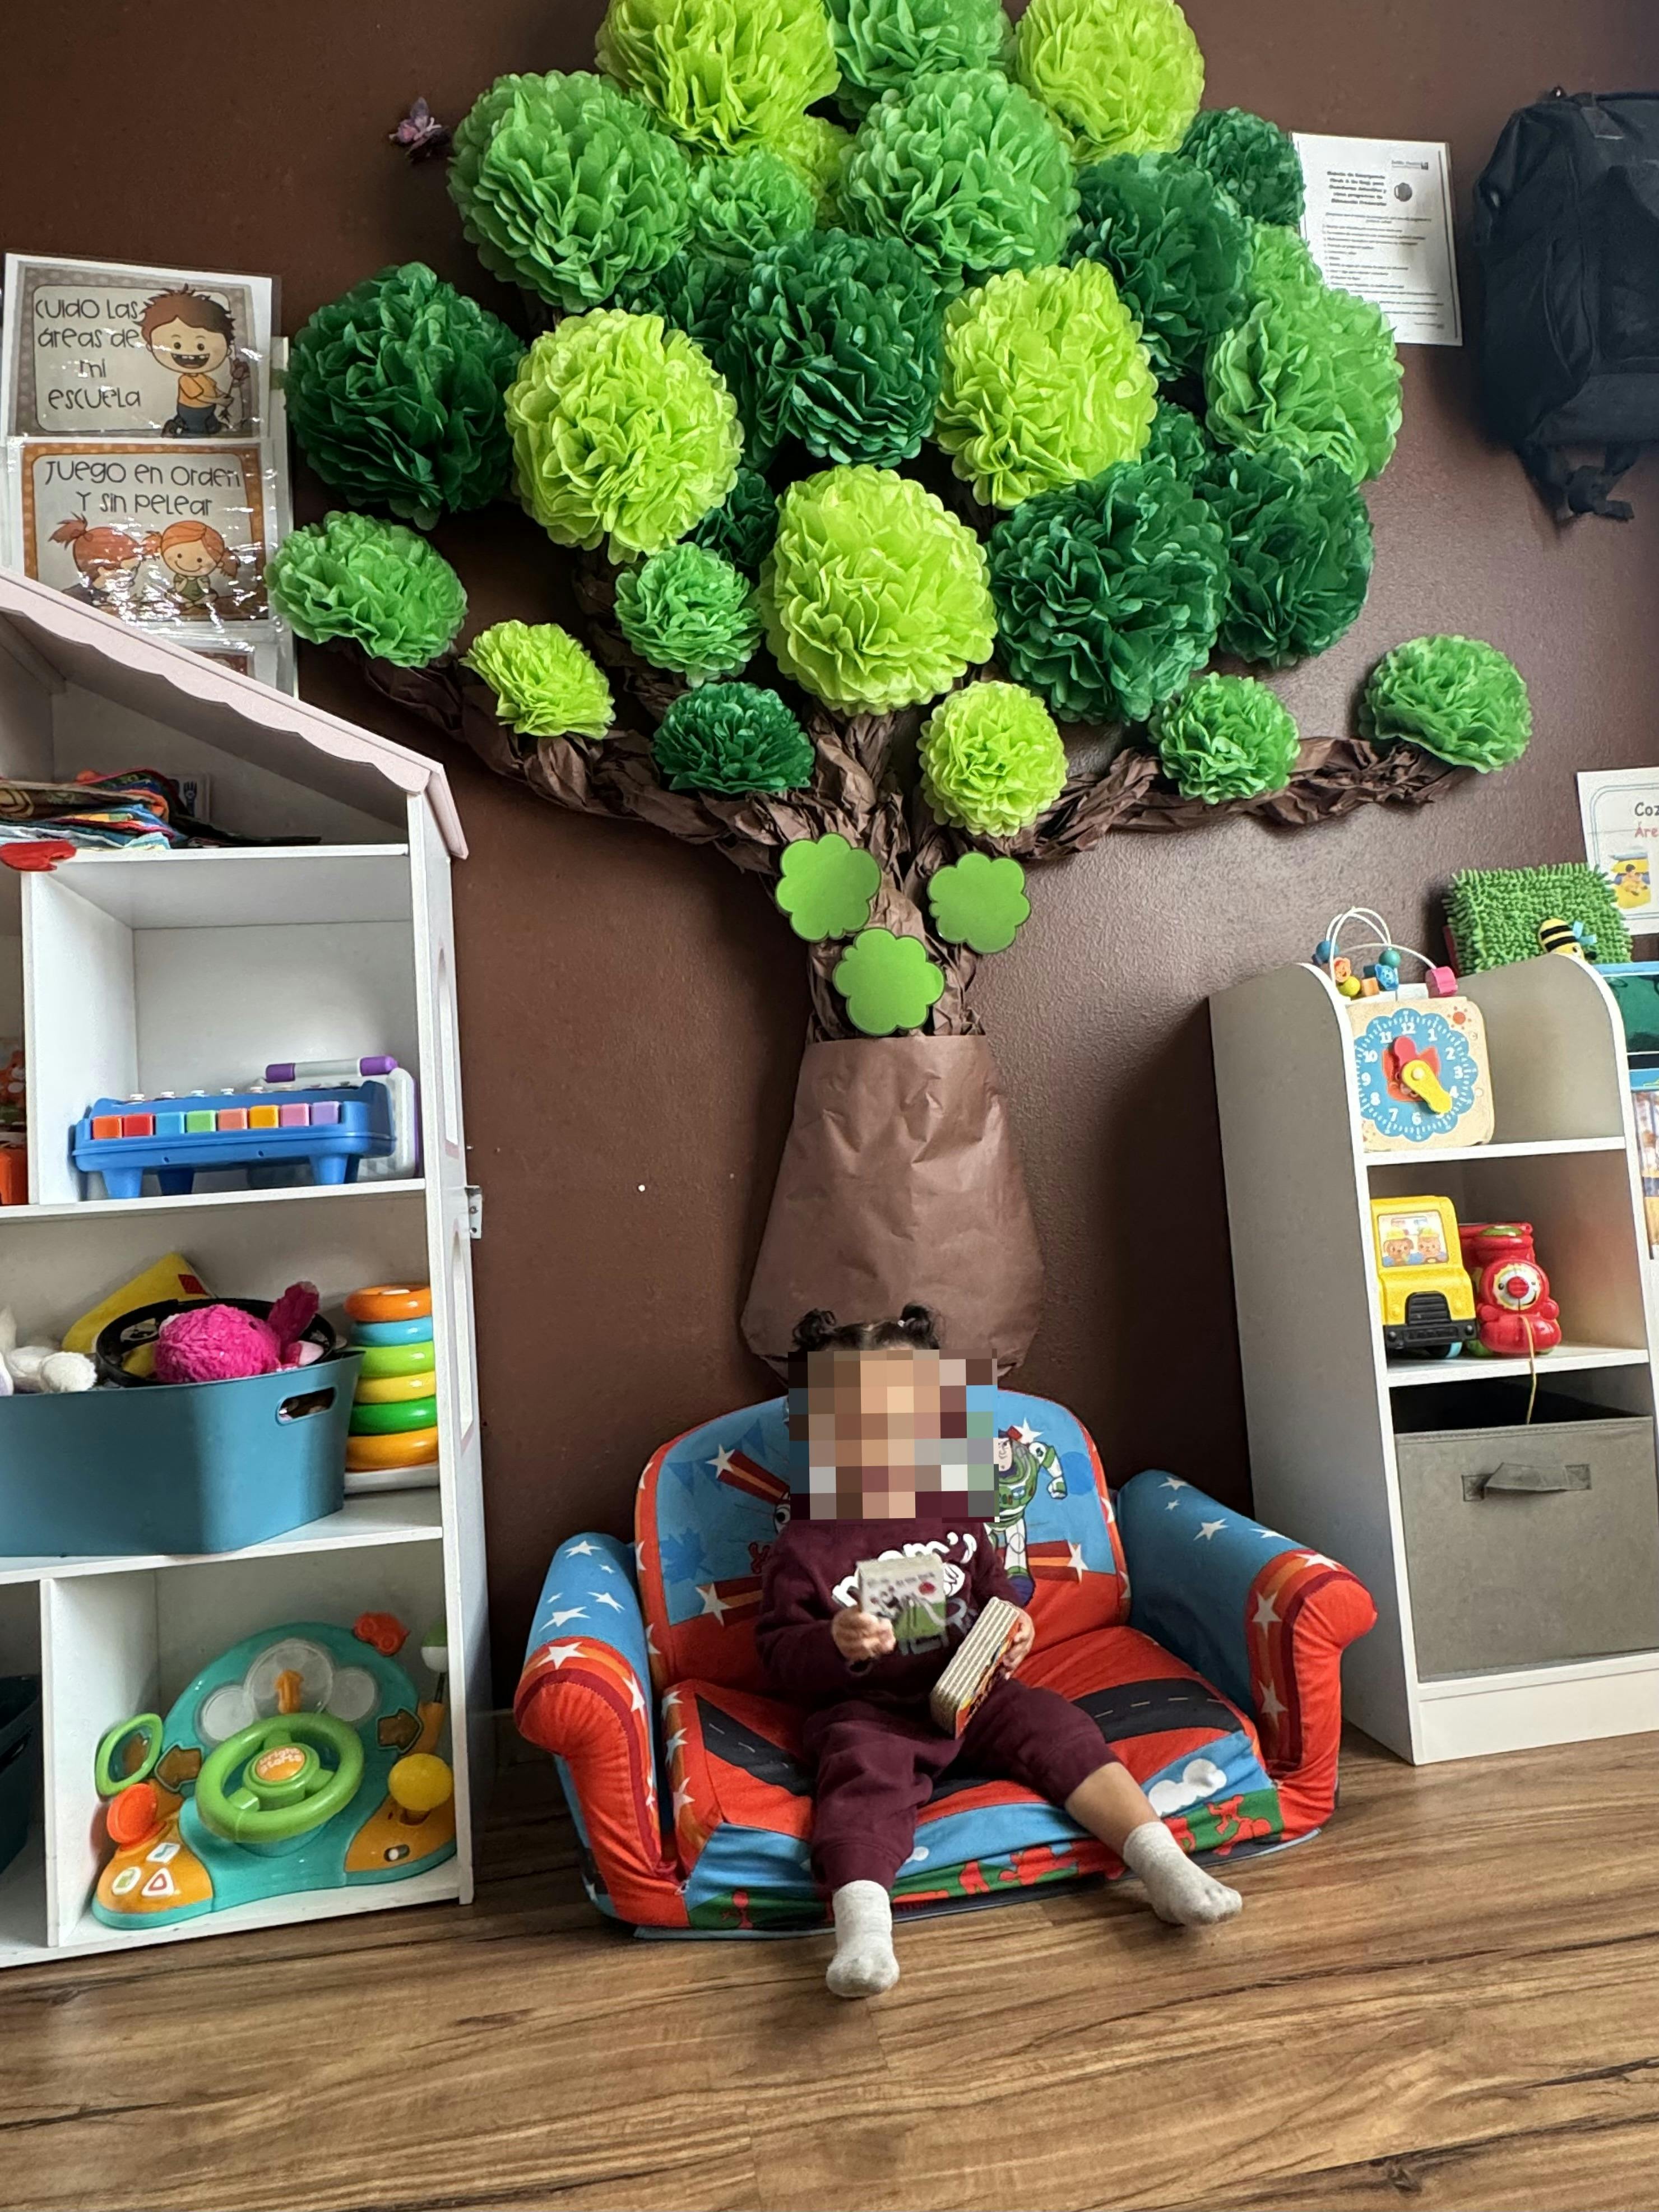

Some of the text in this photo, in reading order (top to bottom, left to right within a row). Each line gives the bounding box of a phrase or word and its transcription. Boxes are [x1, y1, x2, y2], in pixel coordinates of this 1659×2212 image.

[38, 327, 140, 348] áreas de
[135, 464, 163, 484] en
[100, 493, 127, 513] sin
[1401, 1022, 1416, 1035] 12
[1428, 1028, 1438, 1041] 1
[1379, 1031, 1392, 1044] 11
[1363, 1050, 1378, 1063] 10
[1445, 1047, 1456, 1060] 2
[1361, 1072, 1371, 1086] 9
[1454, 1066, 1463, 1079] 3
[1370, 1092, 1380, 1106] 8
[1389, 1107, 1398, 1122] 7
[1412, 1112, 1421, 1125] 6
